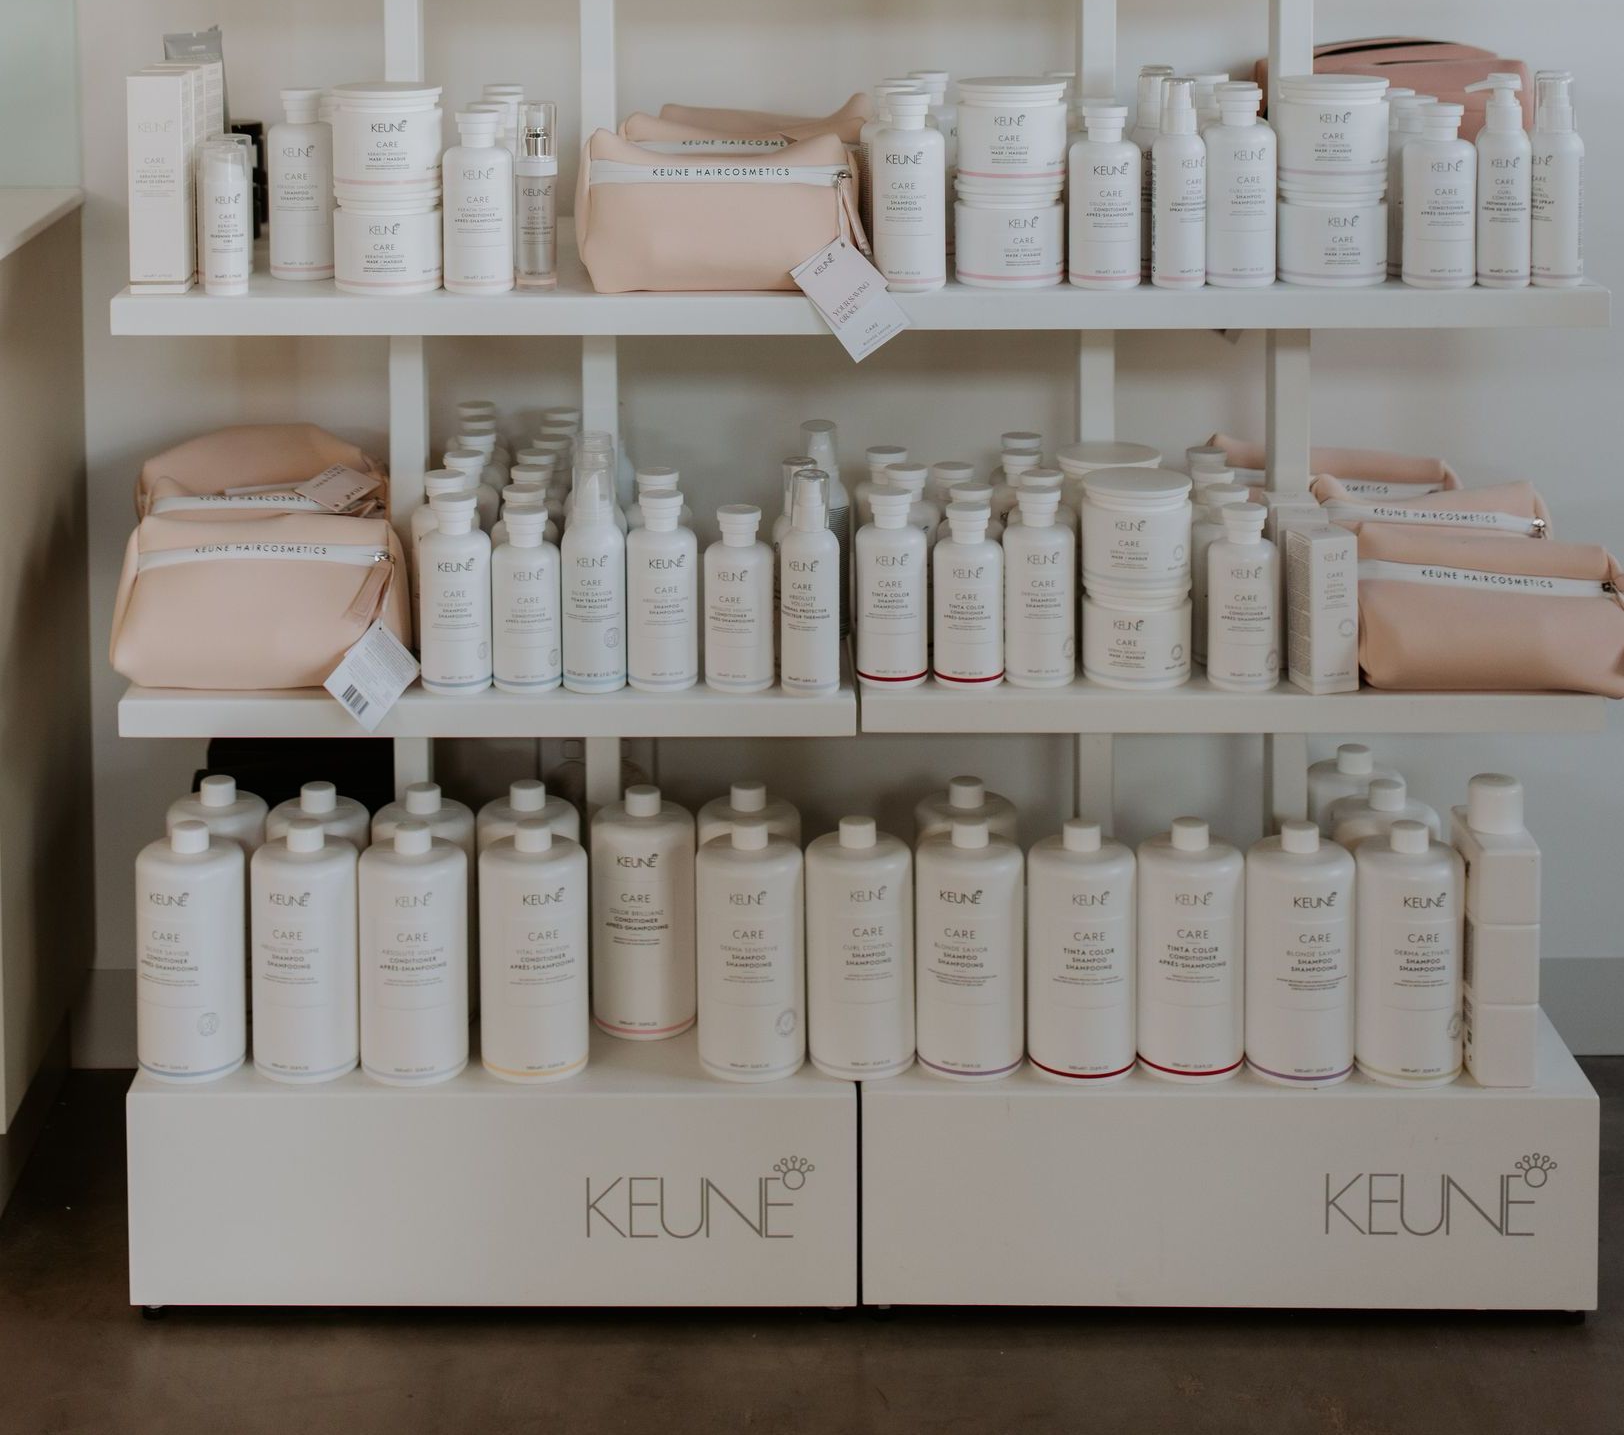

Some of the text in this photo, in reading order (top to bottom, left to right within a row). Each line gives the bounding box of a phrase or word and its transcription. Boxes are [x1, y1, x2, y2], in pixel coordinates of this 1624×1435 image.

[994, 116, 1024, 126] KEUNE
[1319, 113, 1350, 124] KEUNE
[371, 123, 405, 133] KEUNE
[719, 139, 788, 147] HAIRCOSME
[283, 147, 313, 157] KEUNE
[1233, 150, 1265, 161] KEUNE
[886, 153, 922, 165] KEUNE
[652, 167, 790, 176] KEUNE HAIRCOSMETICS
[1094, 164, 1128, 176] KEUNE
[1432, 162, 1462, 172] KEUNE
[463, 170, 492, 180] KEUNE
[523, 188, 550, 196] KEUNE
[1008, 218, 1037, 228] KEUNE
[1328, 216, 1358, 228] KEUNE
[369, 225, 399, 235] KEUNE
[1373, 508, 1497, 523] KEUNE HAIRCOSMETICS
[1115, 521, 1145, 531] KEUNE
[236, 545, 328, 555] HAIRCOSMETICS
[576, 557, 606, 568] KEUNE
[649, 557, 684, 569] KEUNE
[876, 555, 908, 566] KEUNE
[1026, 554, 1059, 565] KEUNE
[438, 561, 472, 573] KEUNE
[953, 568, 983, 579] KEUNE
[1231, 568, 1261, 580] KEUNE
[1422, 569, 1554, 588] KEUNE HAIRCOSMETICS
[878, 580, 902, 588] CARE
[1113, 621, 1143, 631] KEUNE
[617, 855, 657, 868] KEUNE
[149, 893, 189, 907] KEUNE
[269, 893, 310, 907] KEUNE
[395, 895, 431, 908] KEUNE
[523, 891, 564, 905] KEUNE
[621, 894, 651, 903] CARE
[729, 893, 766, 905] KEUNE
[850, 889, 886, 903] KEUNE
[940, 891, 981, 905] KEUNE
[1073, 894, 1108, 906] KEUNE
[1175, 894, 1210, 906] KEUNE
[1294, 896, 1335, 909] KEUNE
[1403, 896, 1444, 908] KEUNE
[614, 916, 658, 924] CONDITIONER
[152, 931, 181, 943] CARE
[272, 930, 302, 941] CARE
[397, 933, 429, 942] CARE
[528, 930, 559, 942] CARE
[733, 930, 764, 939] CARE
[853, 926, 884, 938] CARE
[944, 928, 976, 940] CARE
[1074, 932, 1105, 941] CARE
[1177, 929, 1209, 940] CARE
[1299, 933, 1331, 943] CARE
[1408, 933, 1439, 943] CARE
[1064, 948, 1115, 956] TINTA COLOR
[1193, 946, 1219, 954] COLOR
[389, 956, 437, 964] CONDITIONER
[944, 953, 977, 961] SHAMPOO
[585, 1177, 794, 1238] KEUNE
[1325, 1173, 1535, 1236] KEUNE
